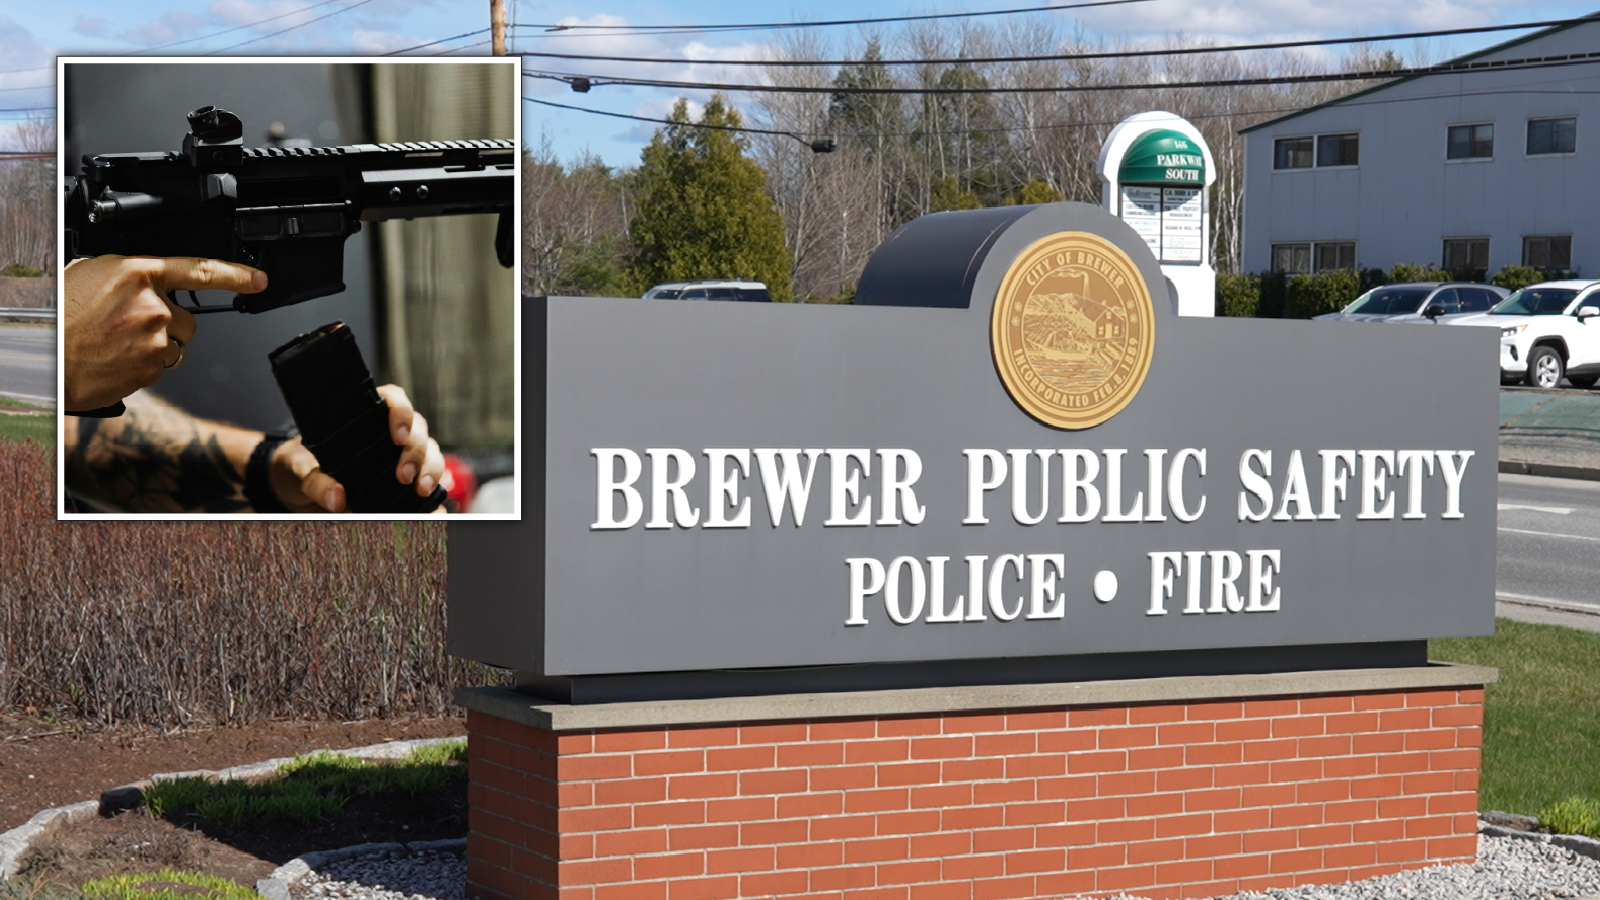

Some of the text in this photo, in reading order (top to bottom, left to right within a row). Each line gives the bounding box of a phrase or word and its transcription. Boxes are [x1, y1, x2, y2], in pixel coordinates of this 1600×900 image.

[1165, 168, 1199, 180] SOUTH
[1026, 251, 1125, 289] CITY OF BREWER
[1013, 348, 1089, 407] INCORPORATED
[1120, 337, 1139, 372] 1889
[591, 448, 1475, 528] BREWER PUBLIC SAFETY
[846, 550, 1280, 624] POLICE FIRE
